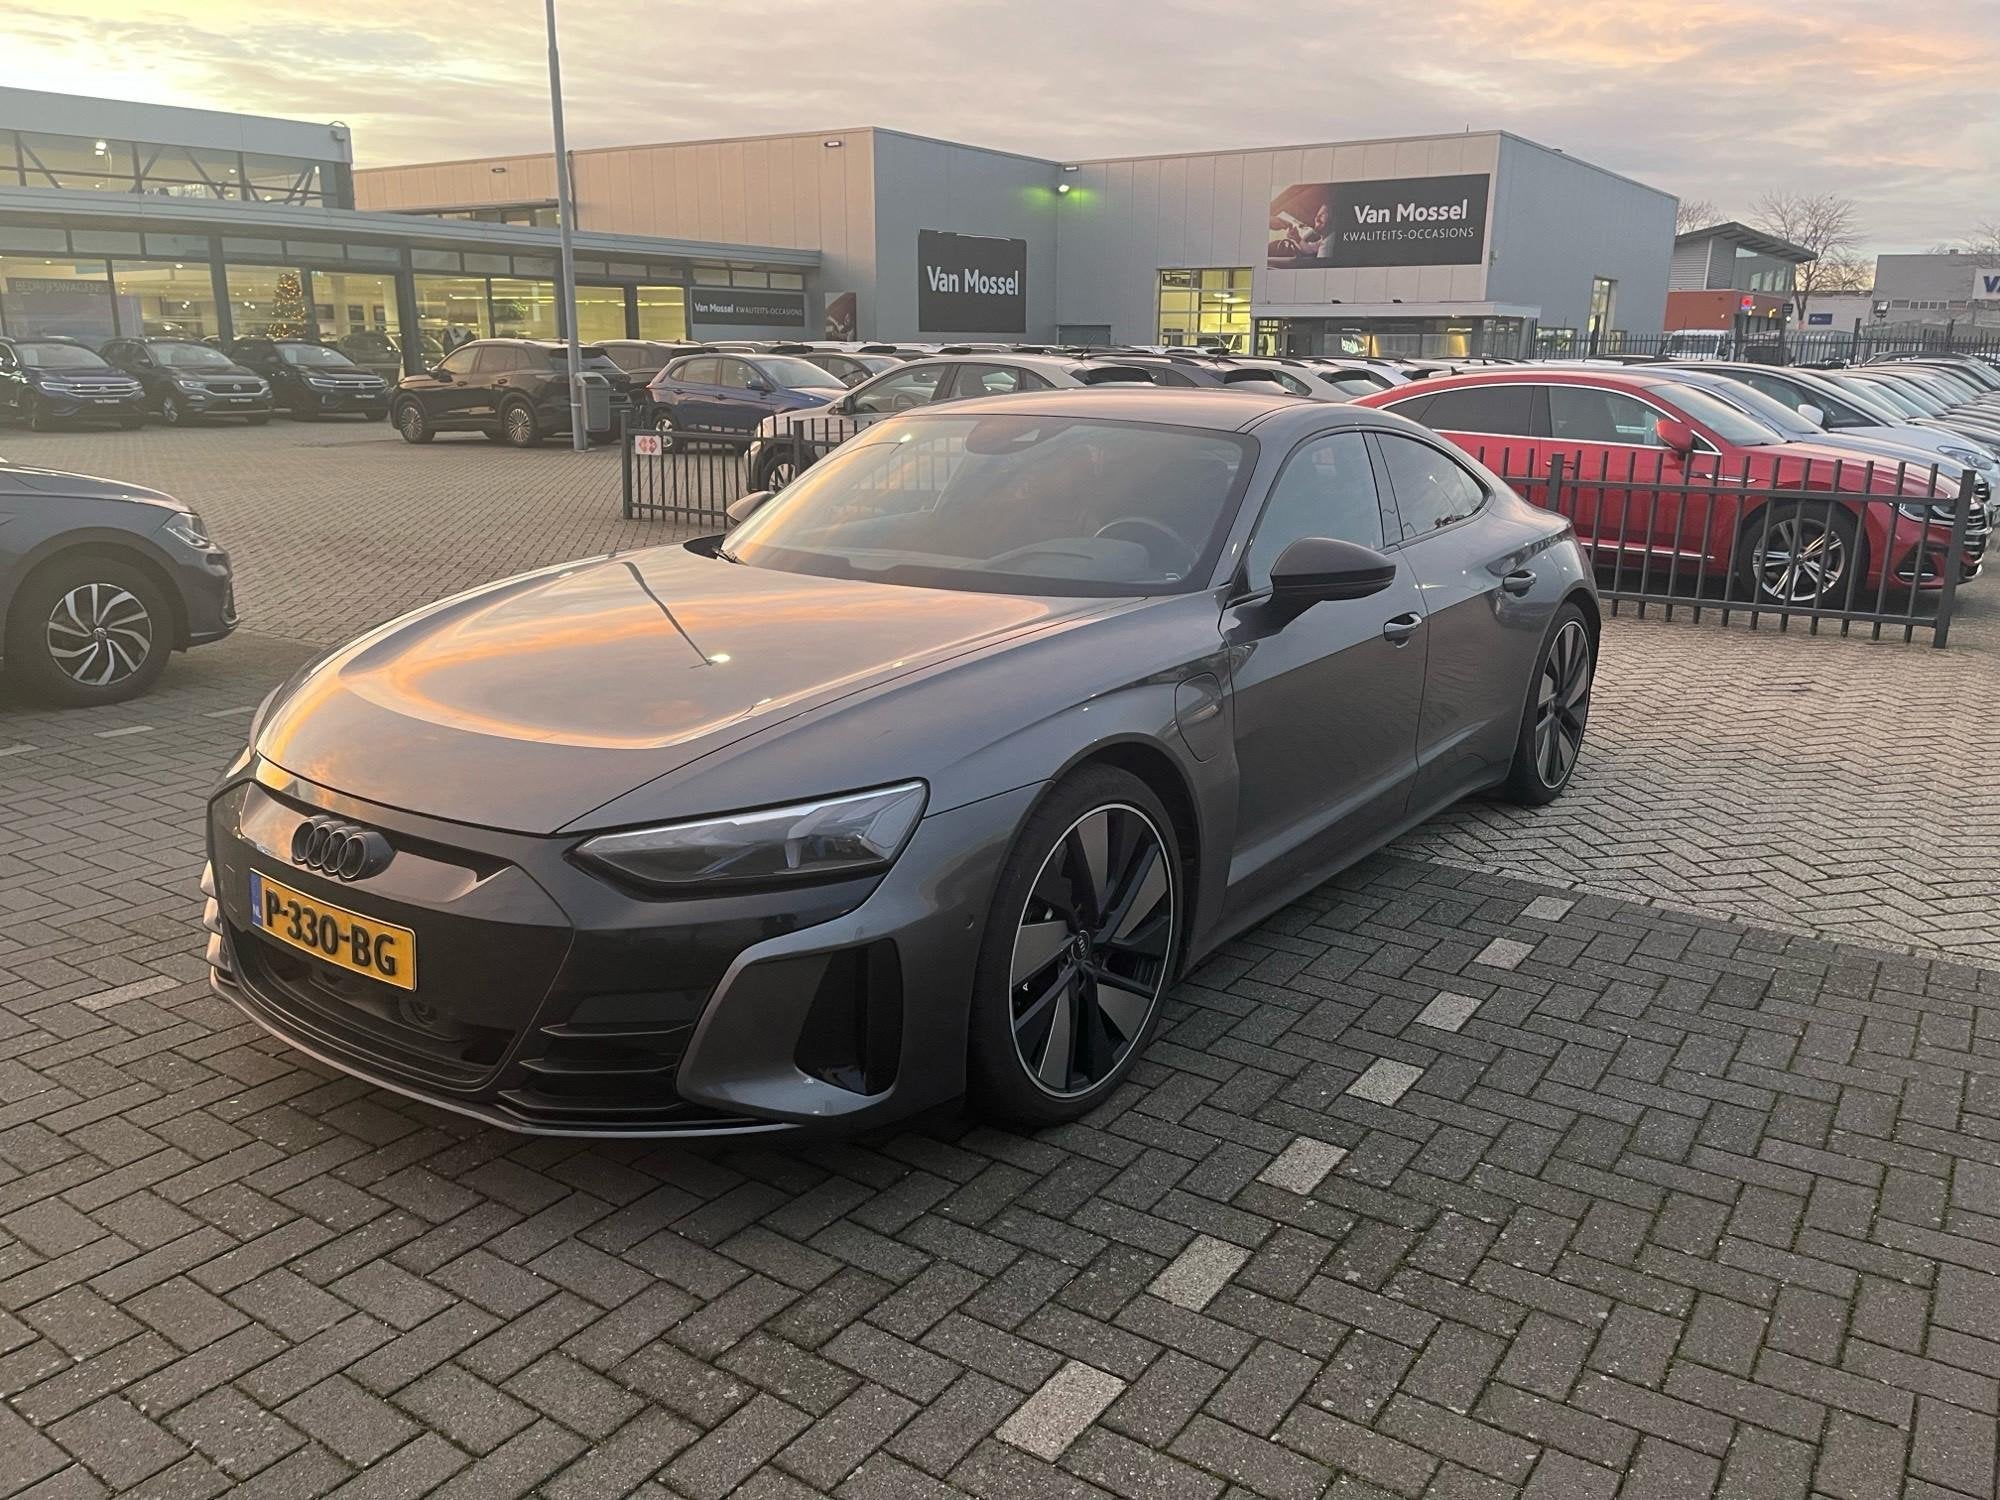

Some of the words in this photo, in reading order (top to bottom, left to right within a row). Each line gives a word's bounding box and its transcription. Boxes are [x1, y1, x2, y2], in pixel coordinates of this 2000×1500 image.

[1354, 203, 1390, 224] Van
[1396, 199, 1468, 222] Mossel
[1343, 226, 1474, 241] KWALITEITS-OCCASIONS
[927, 265, 959, 293] Van
[964, 269, 1019, 296] Mossel
[694, 302, 708, 313] Van
[709, 303, 734, 313] Mossel
[266, 888, 397, 976] P-330-BG
